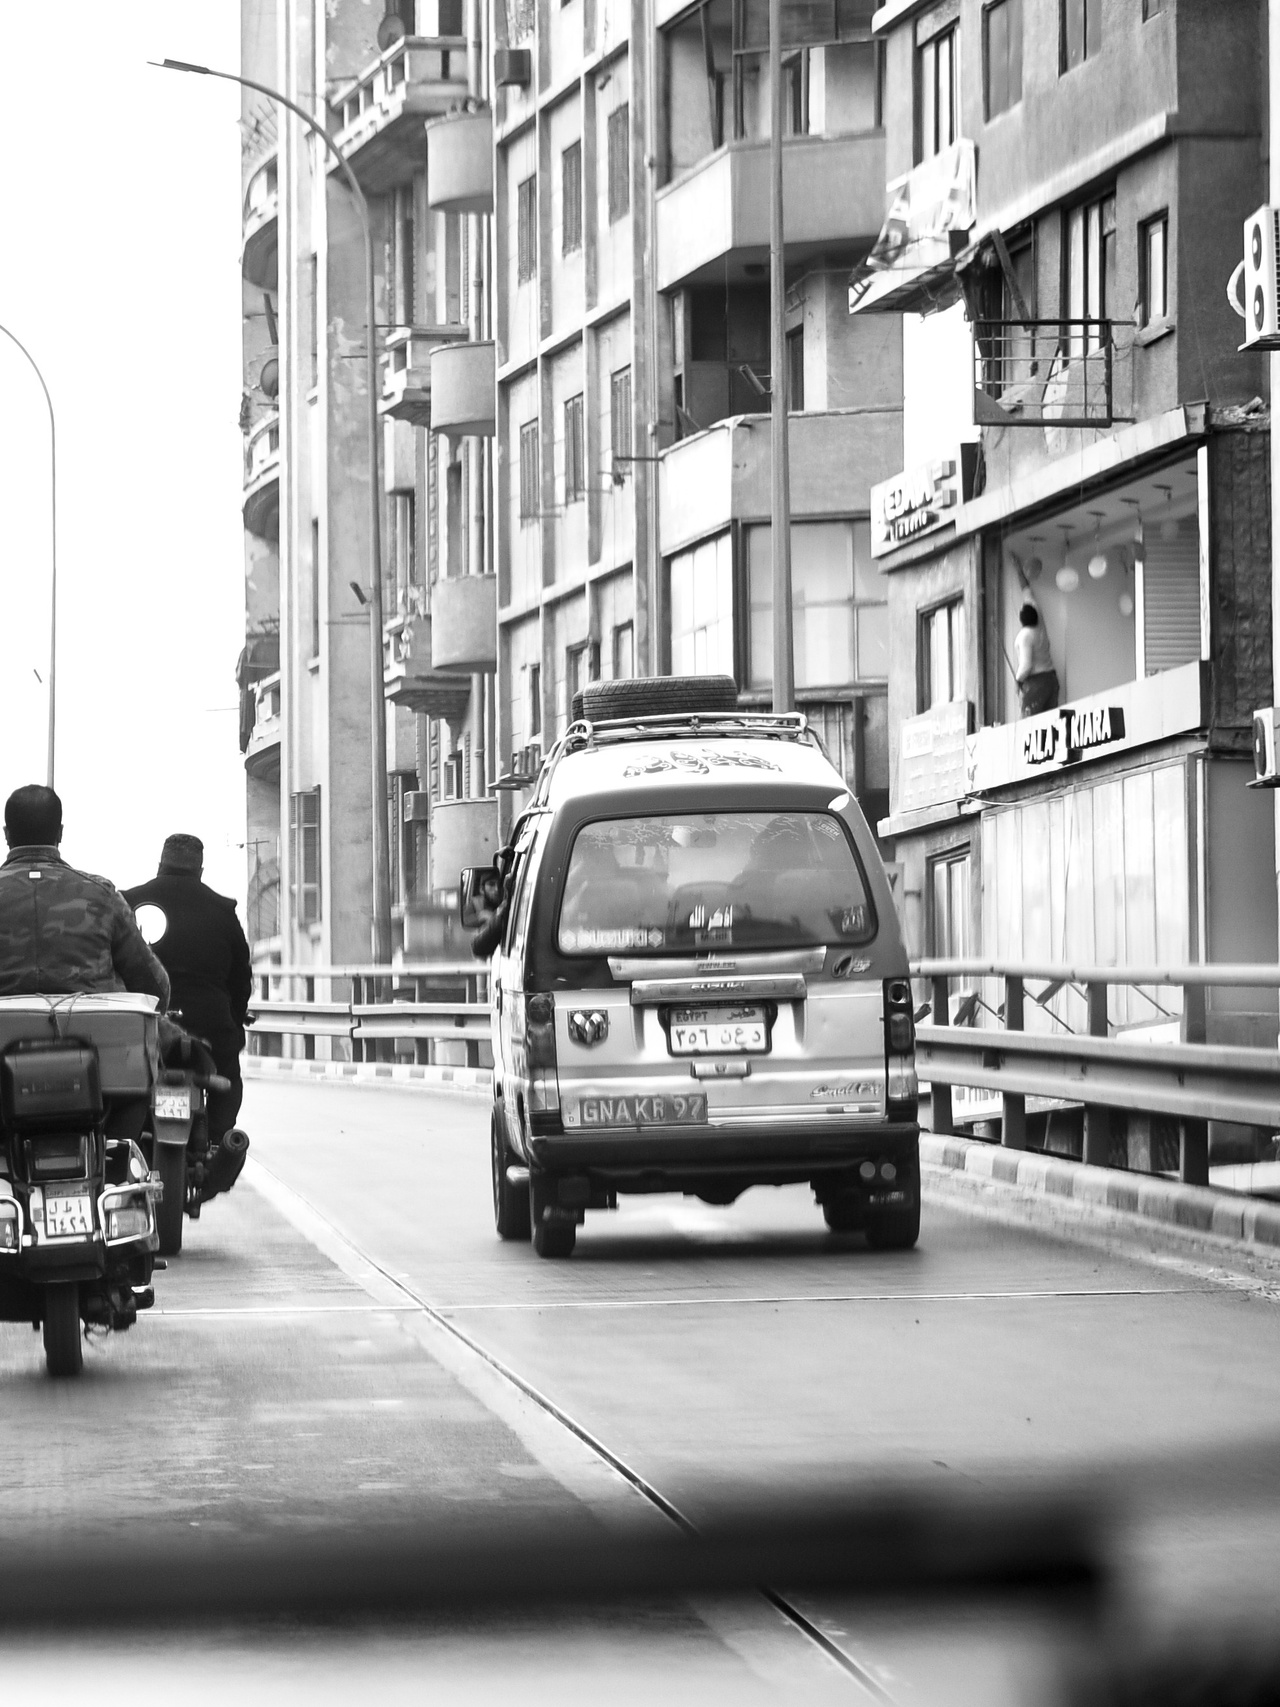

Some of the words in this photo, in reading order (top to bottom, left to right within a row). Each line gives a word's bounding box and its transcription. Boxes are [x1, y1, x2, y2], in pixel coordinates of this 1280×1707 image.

[1071, 704, 1111, 748] KIARA
[675, 1010, 708, 1023] EGYPT
[673, 1096, 705, 1119] 97
